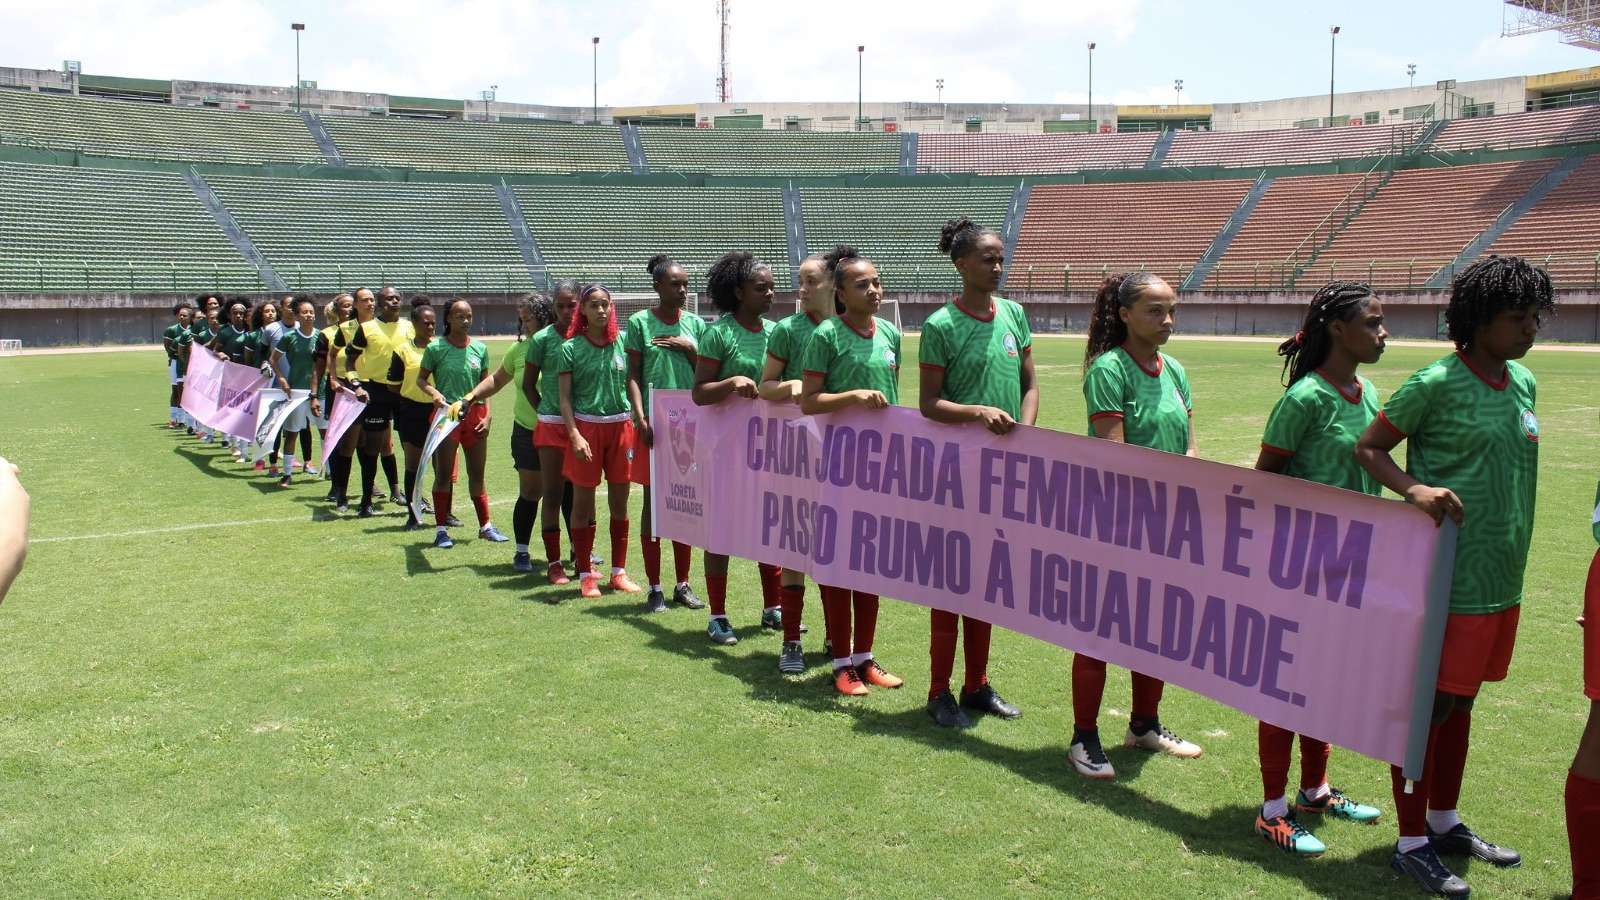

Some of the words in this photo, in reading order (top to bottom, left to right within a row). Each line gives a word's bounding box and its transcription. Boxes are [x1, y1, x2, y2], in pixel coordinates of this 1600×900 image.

[665, 495, 704, 517] VALADARES
[671, 483, 697, 500] LORETA
[746, 415, 811, 480] CADA
[814, 424, 965, 509] JOGADA
[979, 447, 1205, 567] FEMININA
[1222, 484, 1255, 578] É
[1268, 503, 1374, 609] UM
[848, 509, 971, 596] RUMO
[984, 528, 1015, 609] À
[1028, 548, 1307, 708] IGUALDADE.
